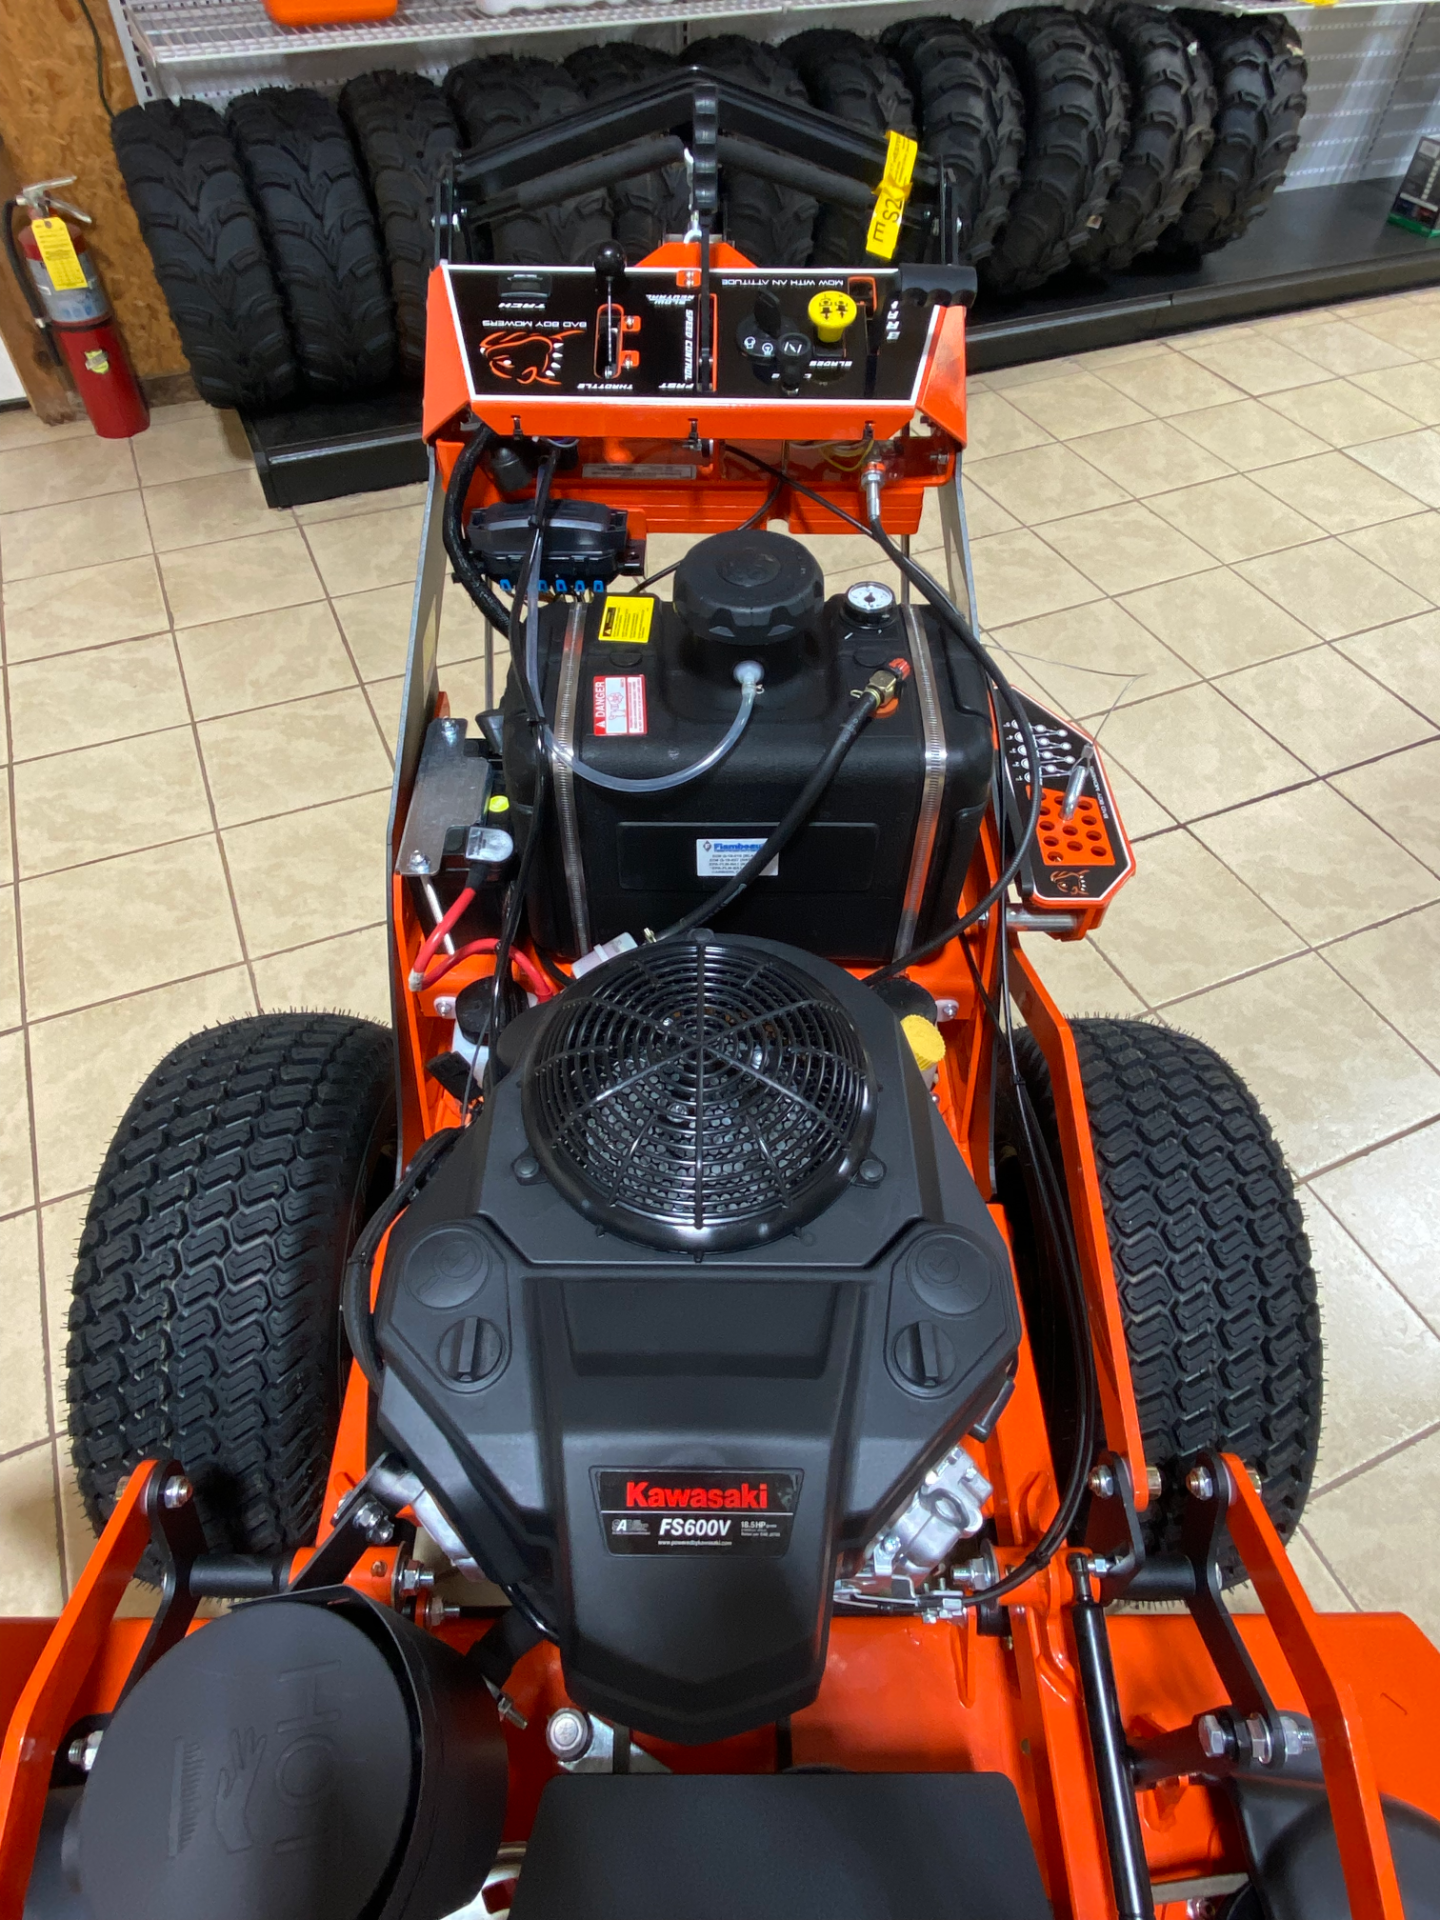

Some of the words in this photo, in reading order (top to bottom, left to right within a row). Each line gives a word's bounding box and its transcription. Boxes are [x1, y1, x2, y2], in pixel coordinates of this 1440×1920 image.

[721, 278, 768, 287] ATTITUDE
[771, 278, 788, 287] AN
[790, 278, 815, 287] WITH
[818, 278, 844, 287] MOW
[482, 320, 533, 328] MOWERS
[685, 308, 694, 339] SPEED
[684, 339, 693, 382] CONTROL
[809, 360, 853, 368] BLADES
[577, 382, 634, 391] THROTTLE
[595, 681, 606, 718] DANGER
[626, 1481, 768, 1509] Kawasaki
[658, 1518, 731, 1536] FS600V
